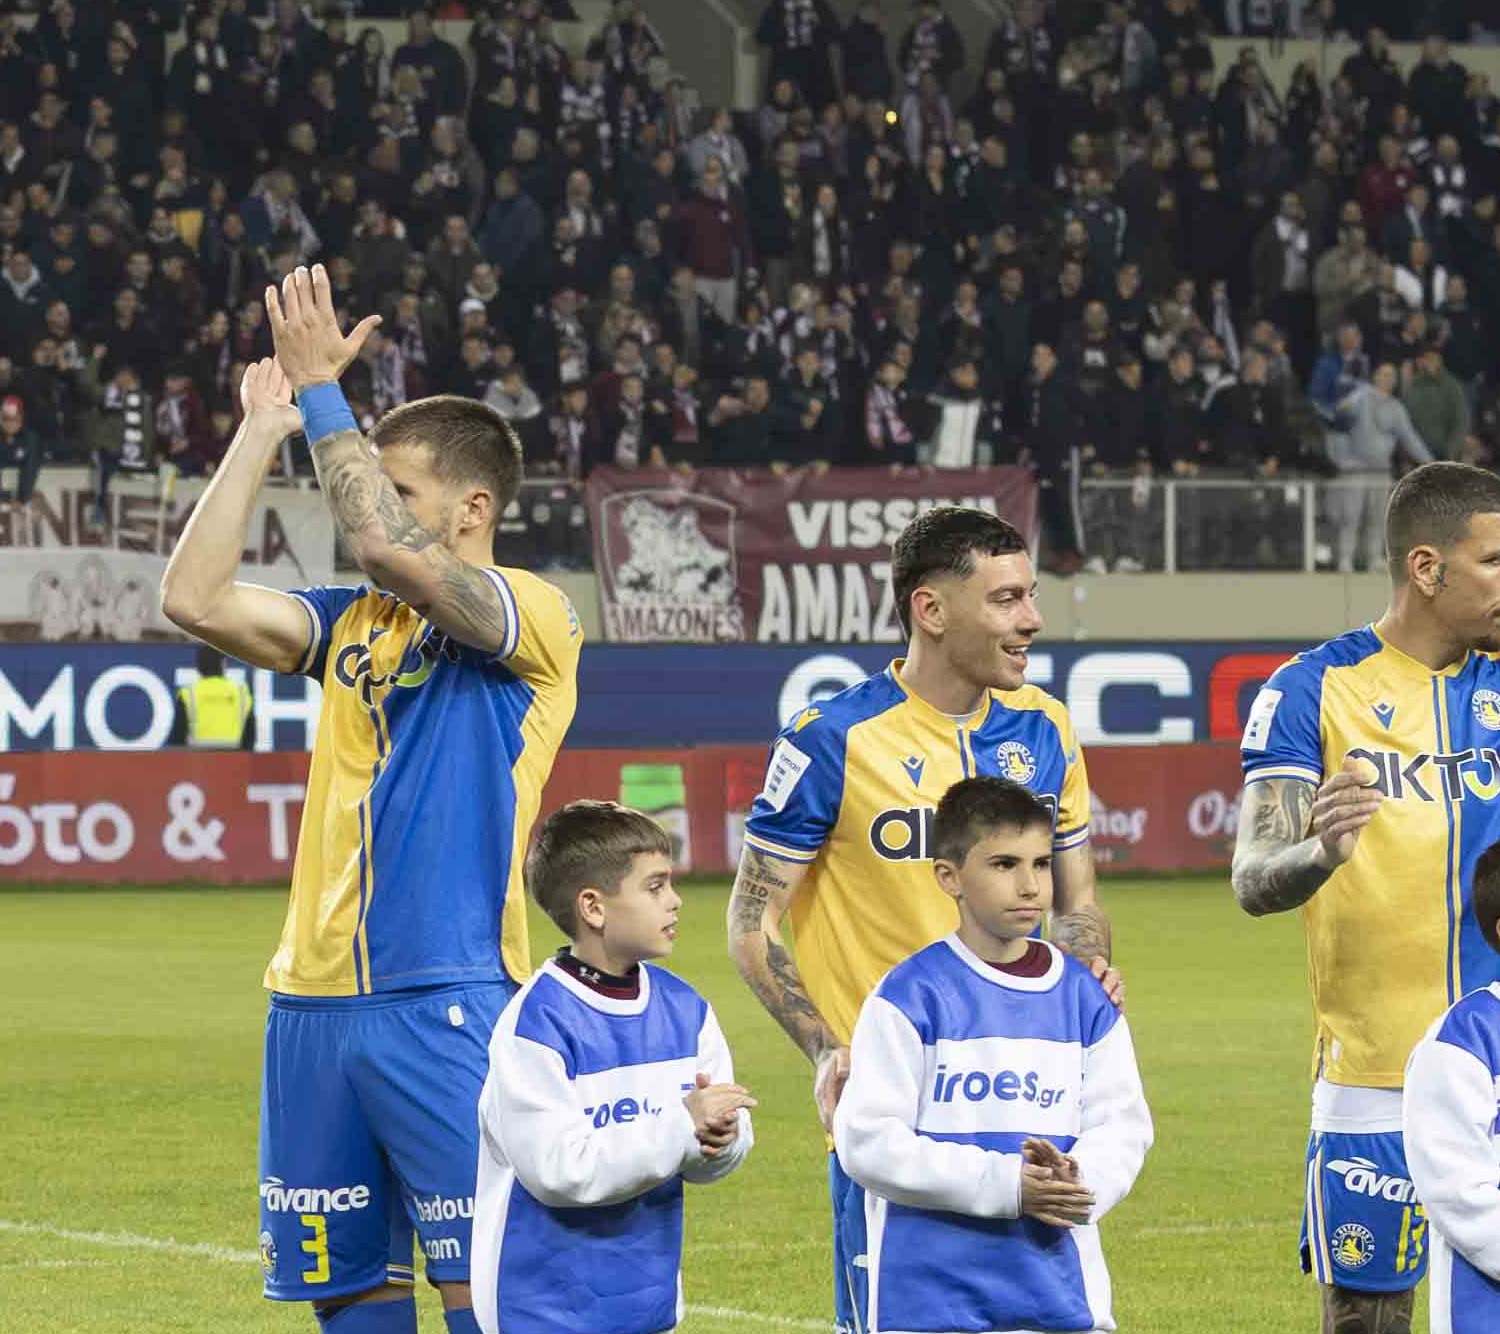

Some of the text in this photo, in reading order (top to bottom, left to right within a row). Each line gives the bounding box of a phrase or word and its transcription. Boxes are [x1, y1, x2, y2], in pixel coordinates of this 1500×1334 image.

[756, 563, 898, 642] AMAZ
[162, 782, 227, 862] &
[933, 1064, 1065, 1109] iroes.gr
[264, 1183, 370, 1213] avance
[300, 1213, 331, 1284] 3
